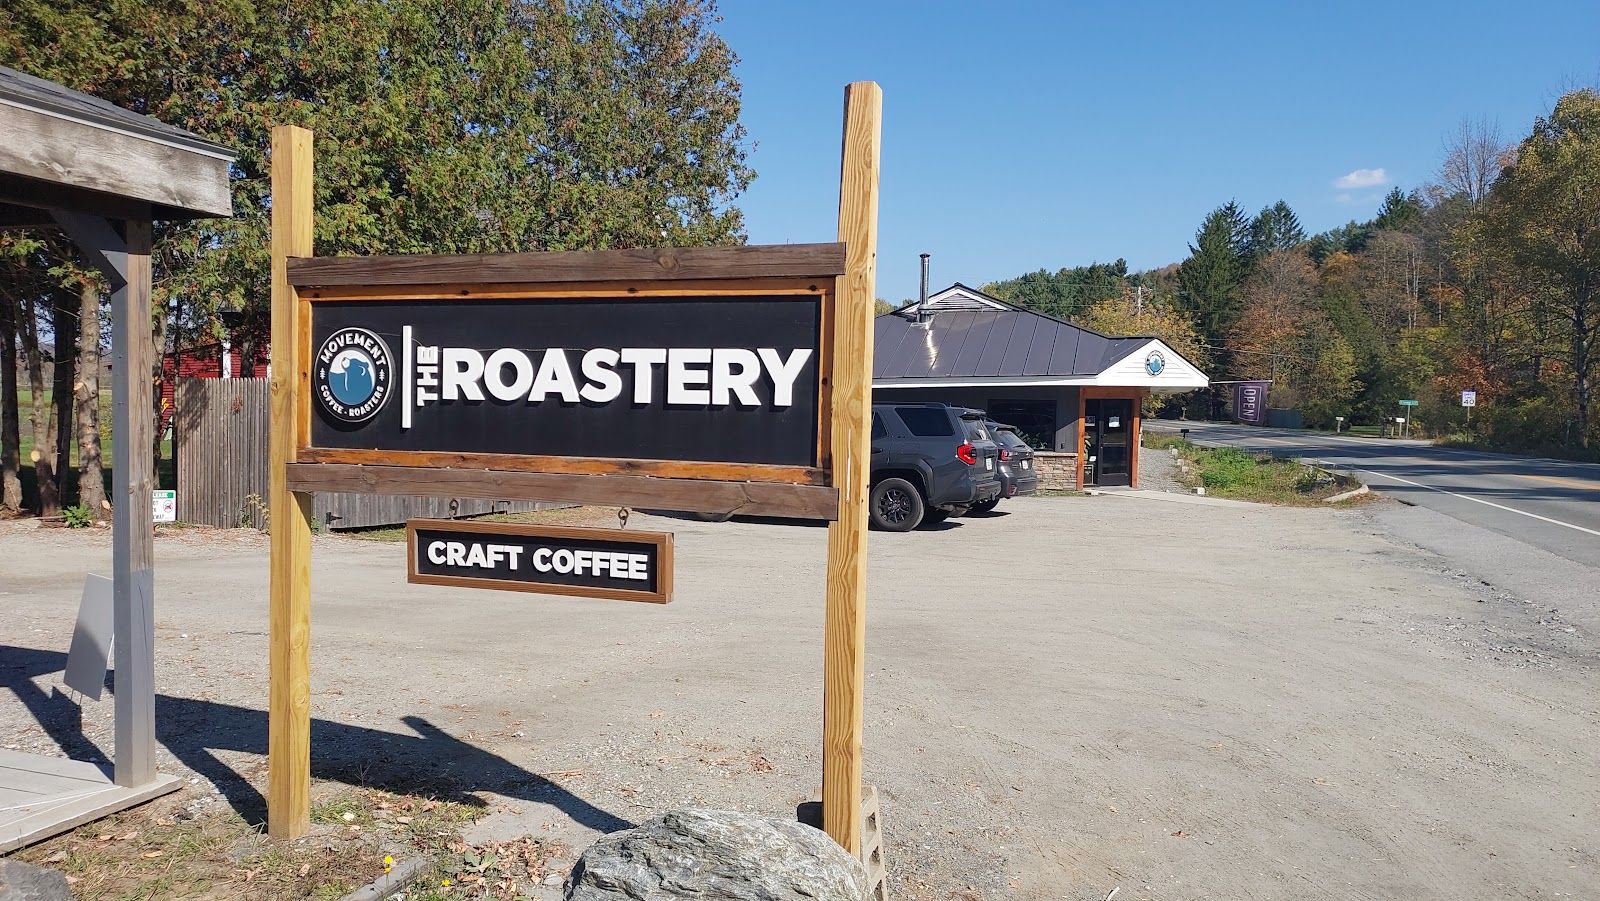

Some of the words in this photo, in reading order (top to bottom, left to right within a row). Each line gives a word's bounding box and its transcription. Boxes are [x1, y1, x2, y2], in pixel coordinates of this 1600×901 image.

[320, 333, 386, 365] MOVEMENT
[417, 346, 438, 406] THE
[442, 348, 812, 406] ROASTERY
[320, 385, 344, 414] COFFEE
[349, 386, 384, 417] ROASTERS
[1242, 389, 1257, 417] OPEN
[427, 541, 523, 570] CRAFT
[532, 548, 648, 580] COFFEE
